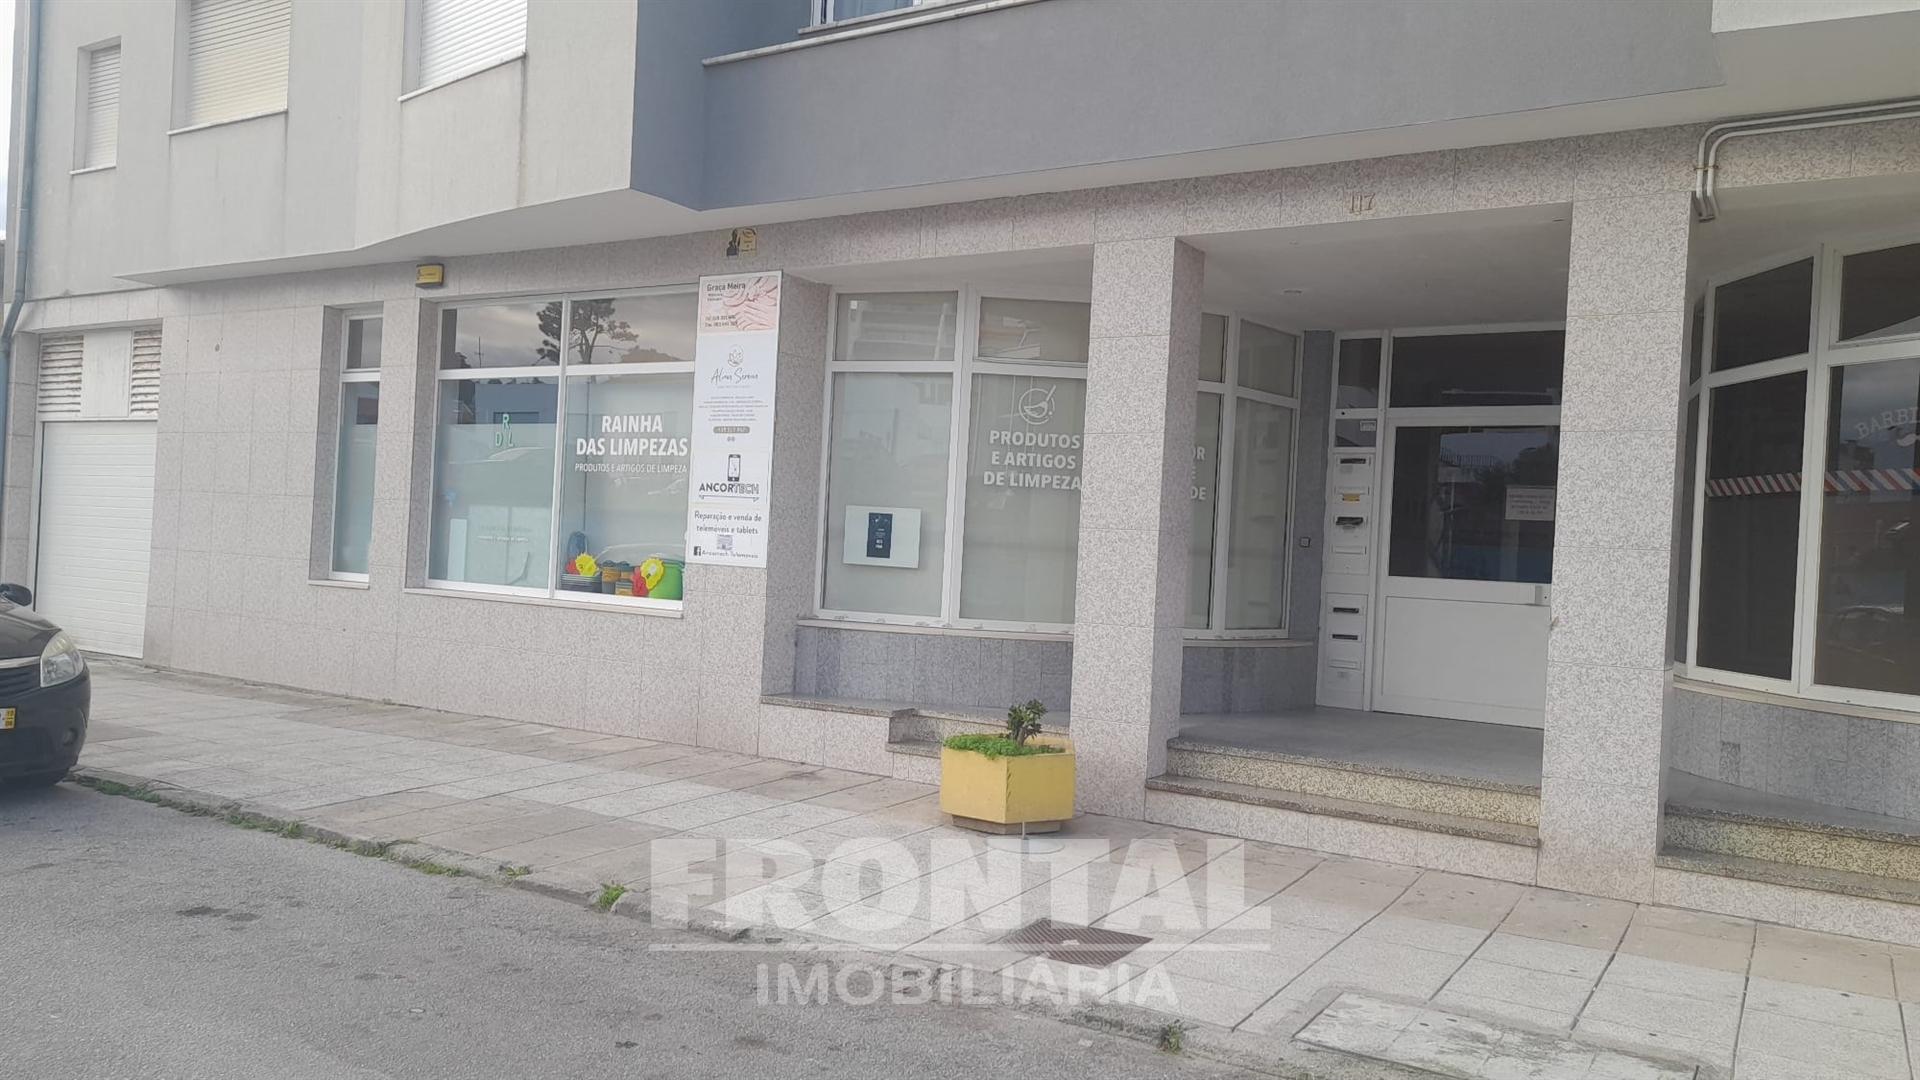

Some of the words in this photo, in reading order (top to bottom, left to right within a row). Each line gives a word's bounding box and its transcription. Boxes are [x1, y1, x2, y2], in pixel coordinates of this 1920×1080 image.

[1349, 192, 1375, 213] 117
[706, 283, 726, 292] Graça
[727, 282, 746, 290] Meira
[601, 414, 663, 433] RAINHA
[576, 438, 606, 456] DAS
[610, 438, 689, 457] LIMPEZAS
[989, 430, 1081, 449] PRODUTOS
[574, 463, 610, 473] PRODUTOS
[611, 463, 615, 473] E
[616, 463, 645, 473] ARTIGOS
[646, 464, 656, 473] DE
[657, 464, 688, 474] LIMPEZA
[991, 451, 1000, 465] E
[1004, 452, 1077, 469] ARTIGOS
[698, 482, 760, 495] ANCORTECH
[983, 471, 1005, 486] DE
[1009, 472, 1082, 490] LIMPEZA
[694, 510, 727, 522] Reparação
[734, 513, 752, 521] venda
[754, 513, 762, 522] de
